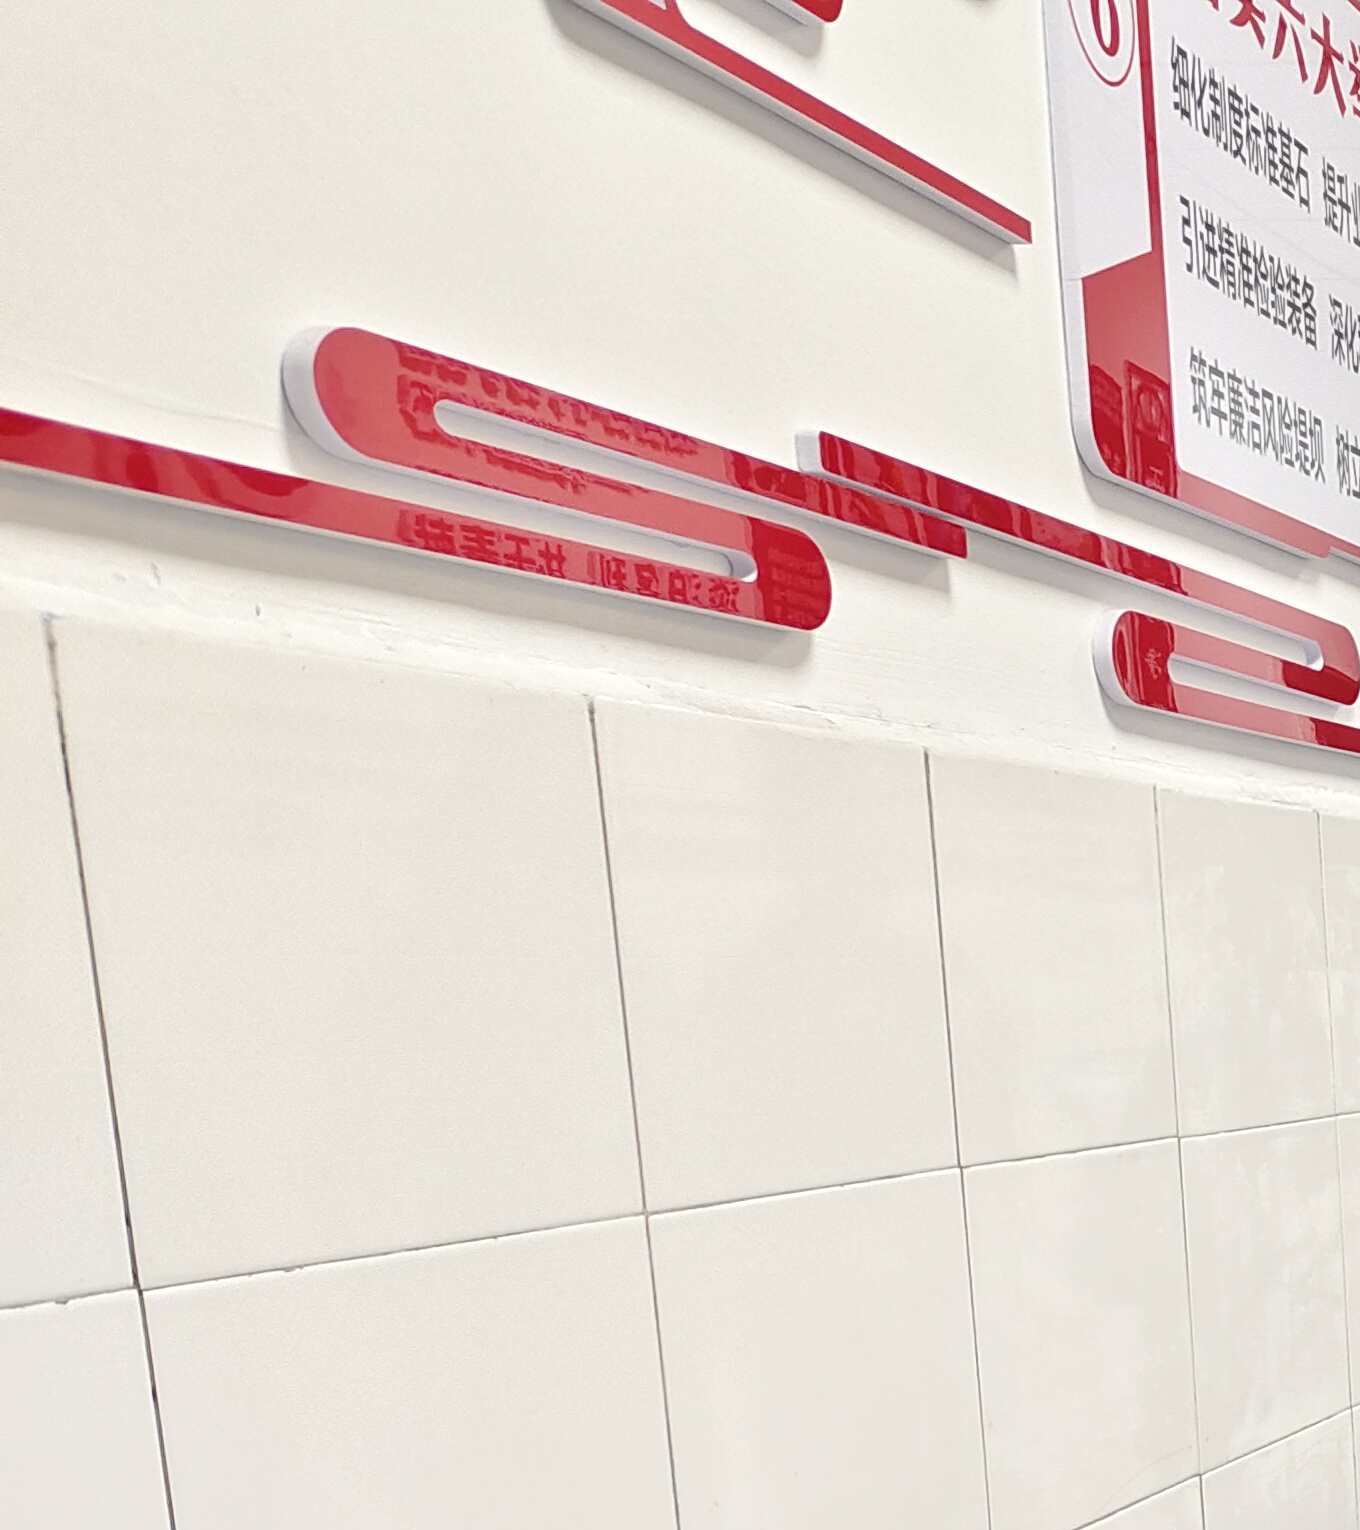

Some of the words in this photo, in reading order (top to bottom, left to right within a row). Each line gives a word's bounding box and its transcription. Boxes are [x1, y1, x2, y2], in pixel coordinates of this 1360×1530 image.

[1170, 35, 1311, 214] 细化制度标准基石
[1178, 194, 1319, 351] 引进精准检验装备
[1189, 345, 1326, 485] 筑牢廉洁风险堤坝
